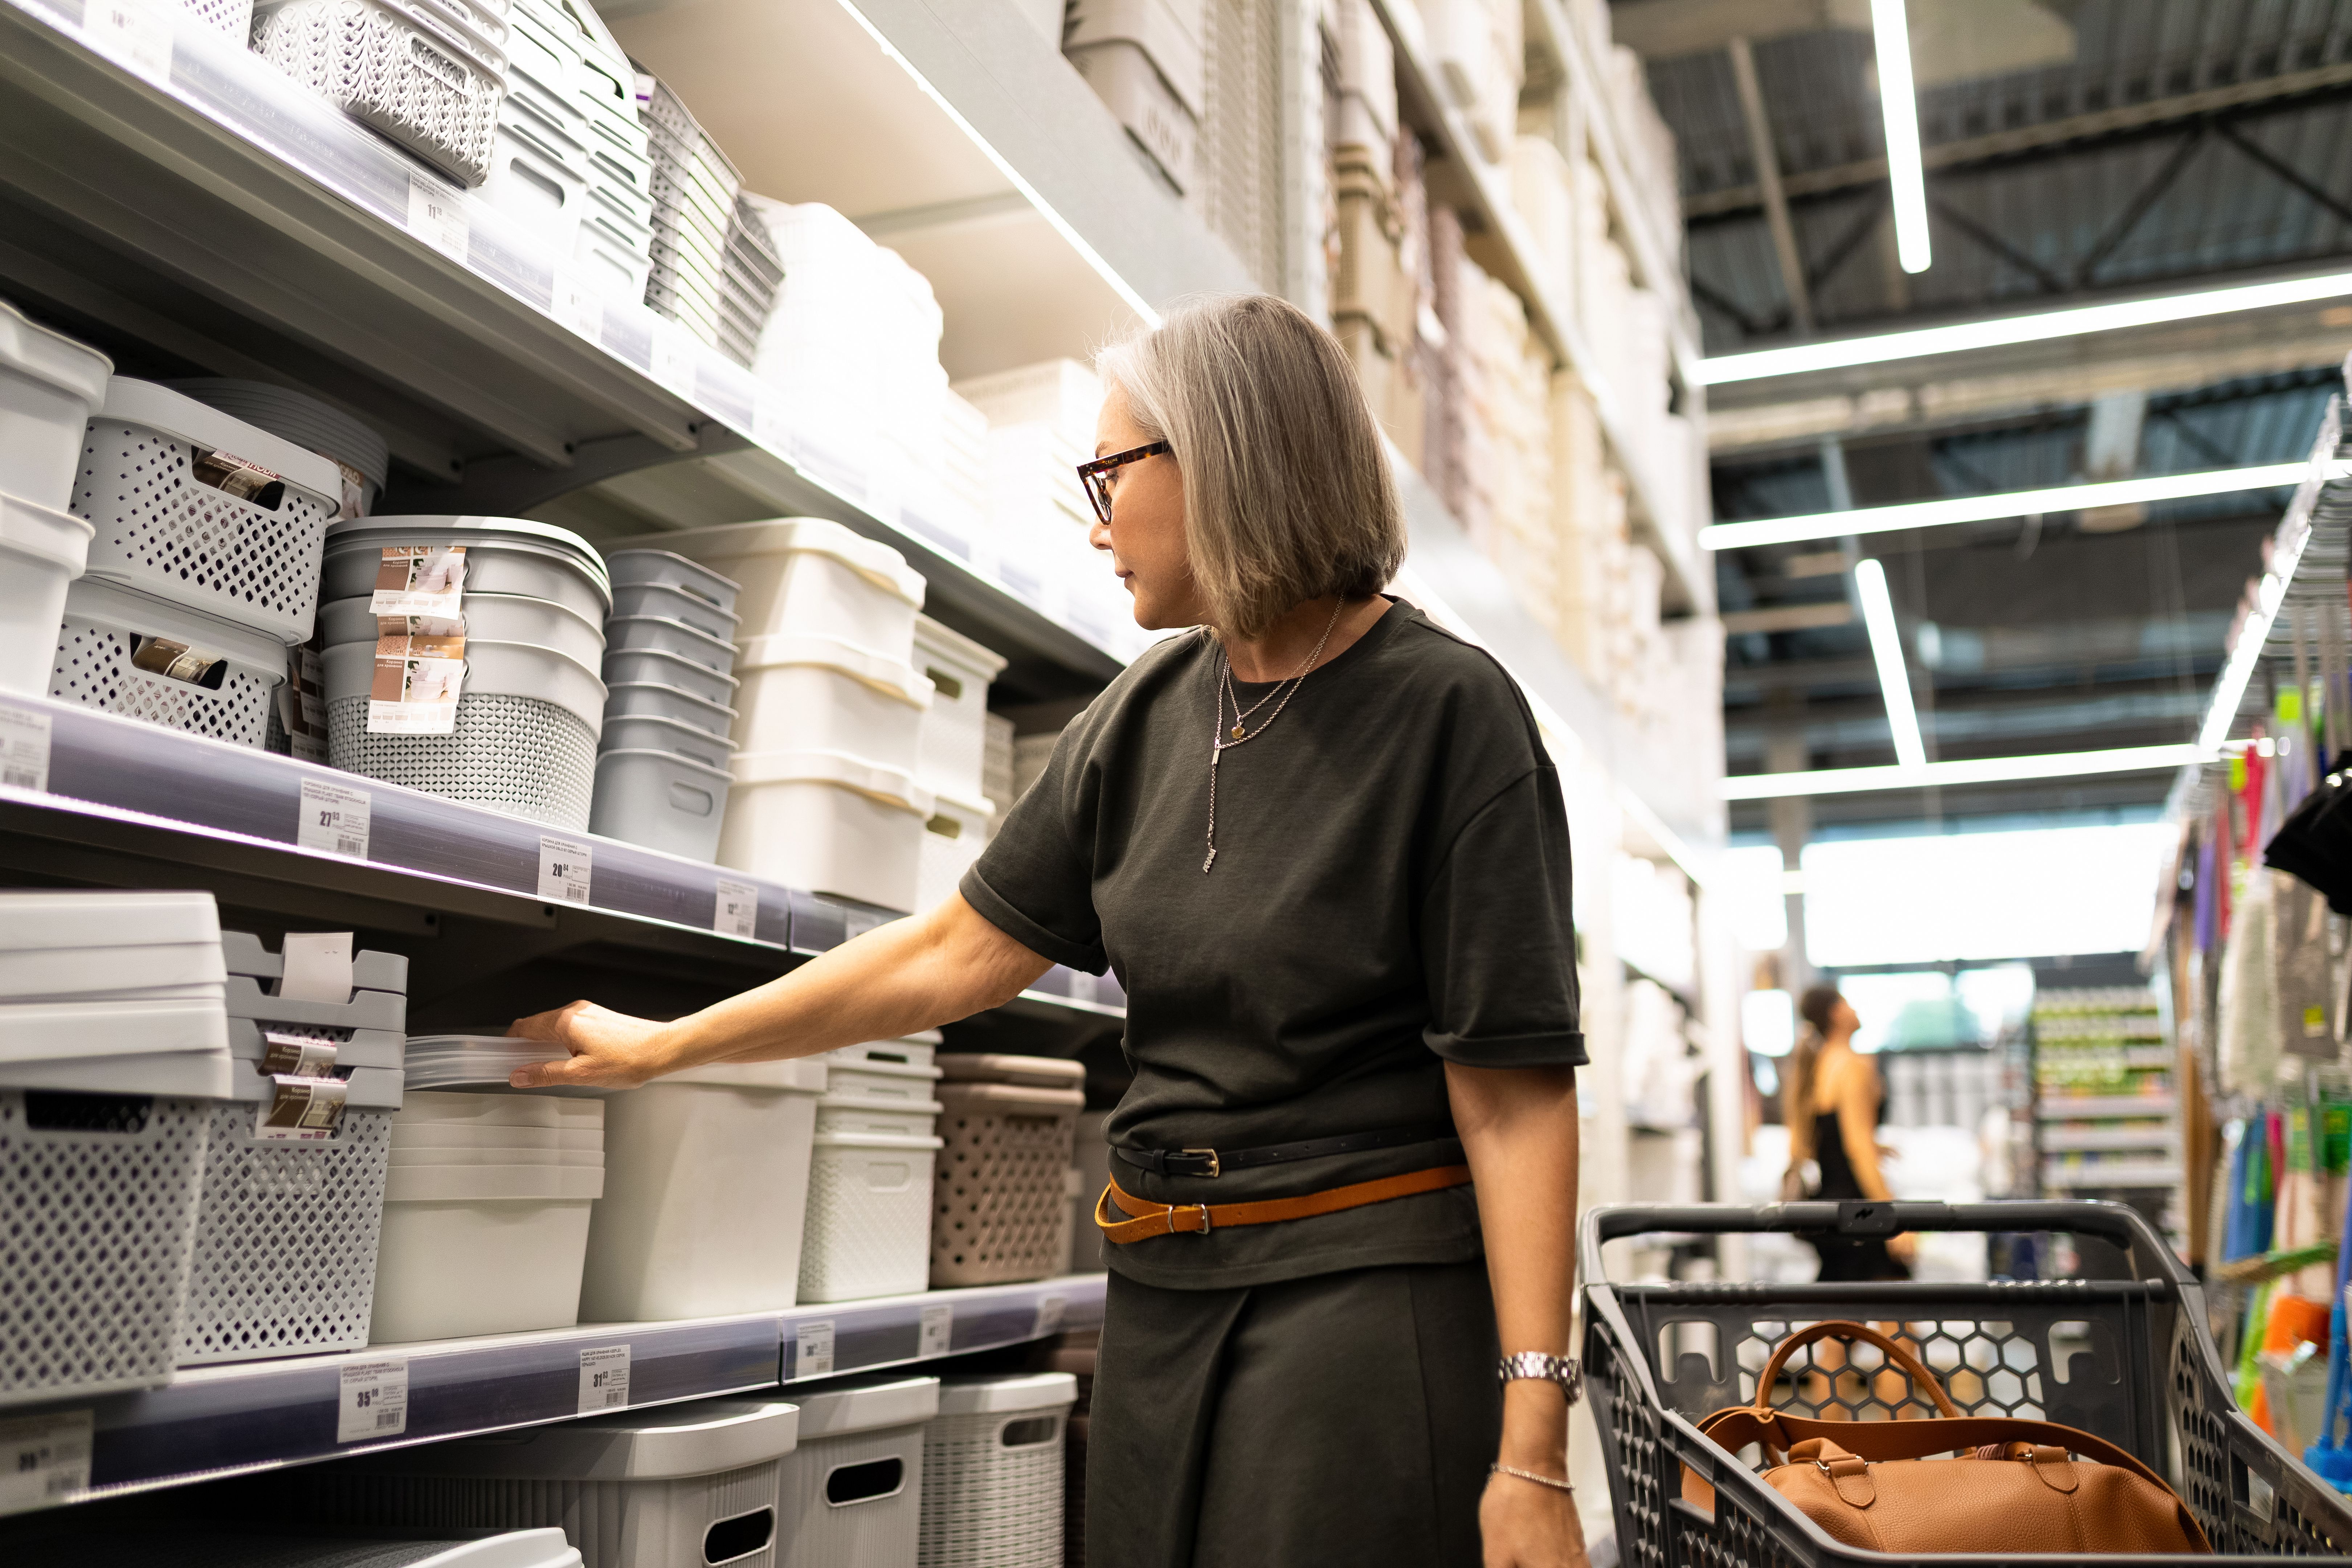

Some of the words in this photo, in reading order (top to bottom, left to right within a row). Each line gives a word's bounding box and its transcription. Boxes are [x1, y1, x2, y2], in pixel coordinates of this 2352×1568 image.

[428, 204, 436, 219] 11
[437, 207, 442, 216] 18
[219, 462, 238, 471] Корзина
[320, 810, 331, 827] 27
[552, 863, 562, 877] 20
[594, 1373, 602, 1387] 31
[357, 1391, 371, 1408] 35
